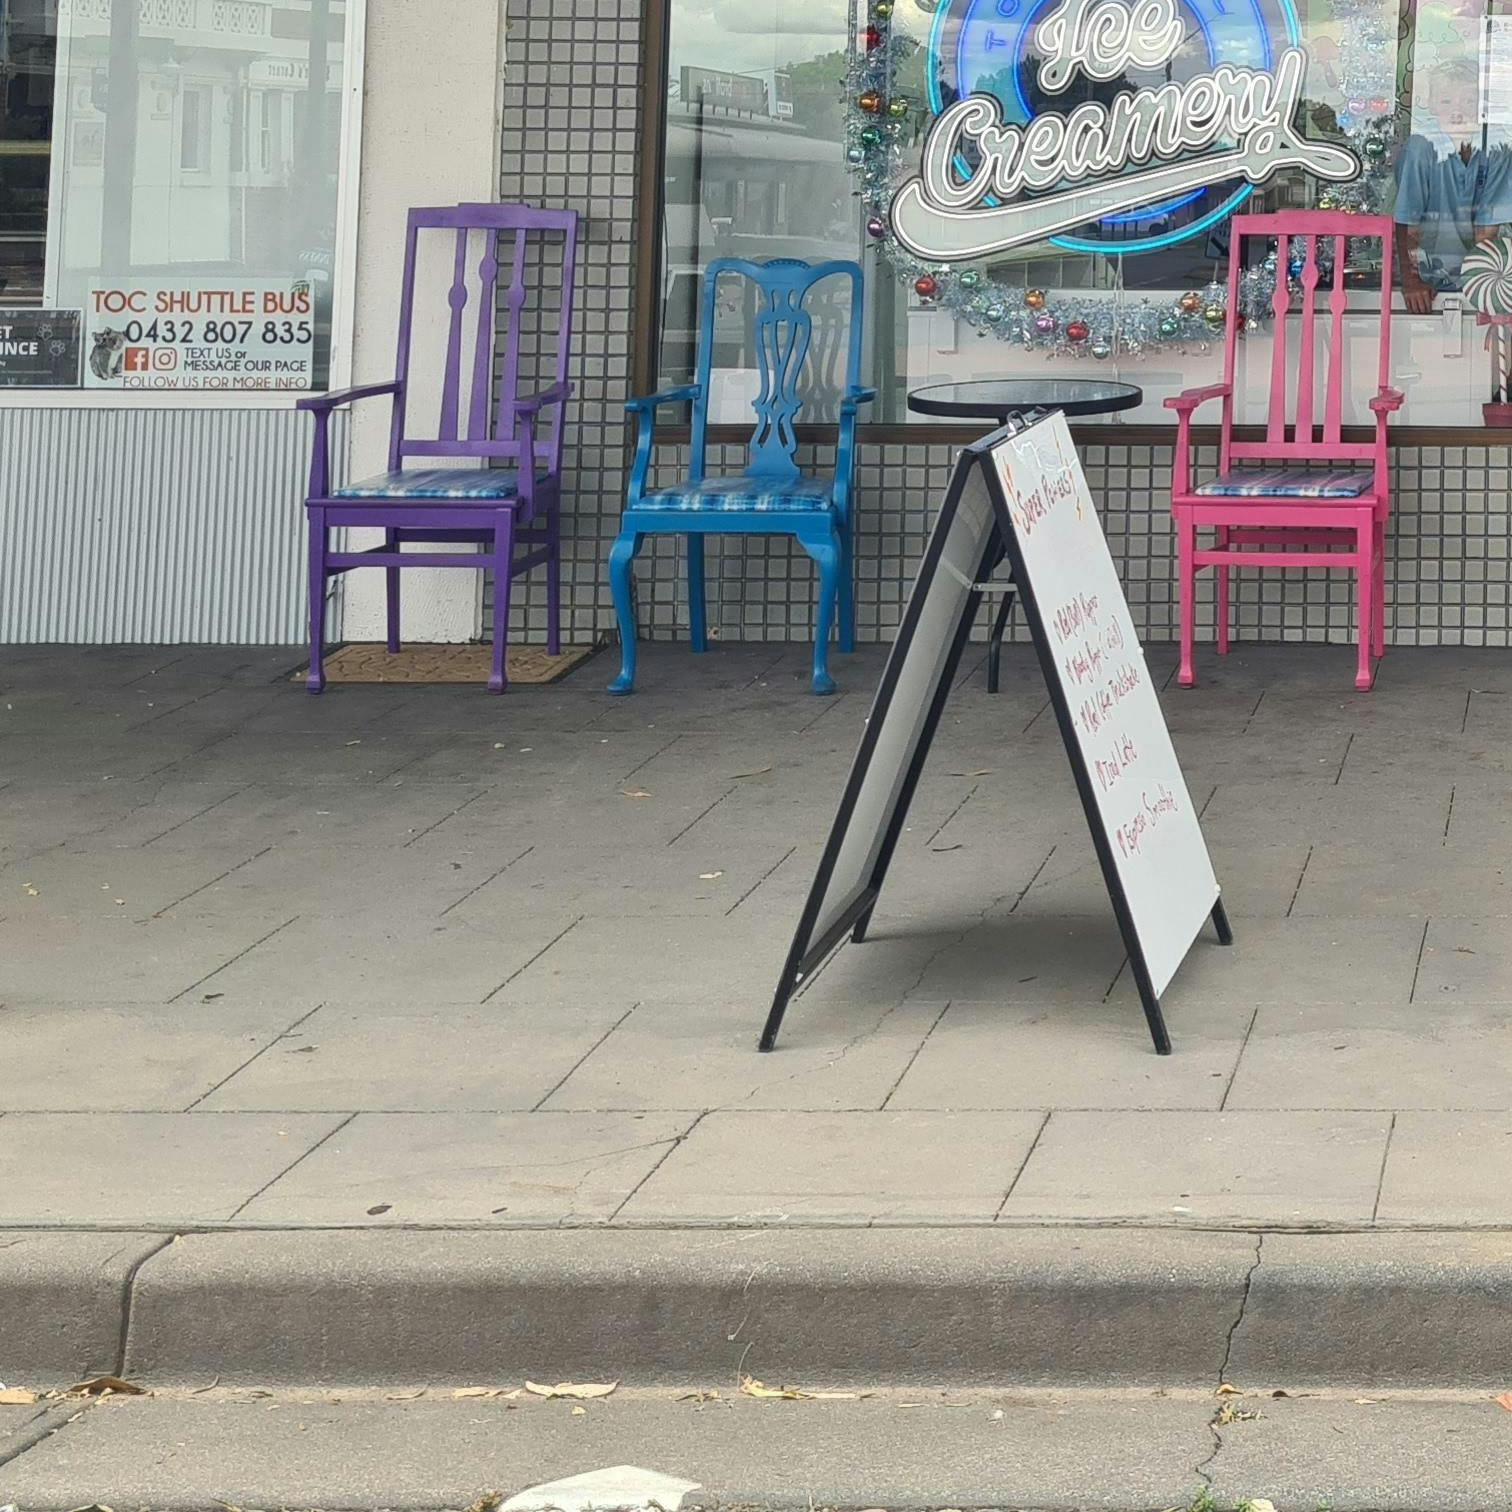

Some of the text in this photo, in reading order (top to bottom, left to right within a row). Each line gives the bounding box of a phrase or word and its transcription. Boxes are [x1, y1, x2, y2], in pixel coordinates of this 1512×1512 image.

[900, 46, 1355, 243] Creamery
[92, 291, 310, 314] TOC SHUTTLE BUS
[126, 317, 312, 344] 0432 807 835
[185, 348, 247, 359] TEXT US or
[184, 360, 307, 372] MESSAGE OUR PAGE
[123, 376, 307, 388] FOLLOW US FOR MORE INFO
